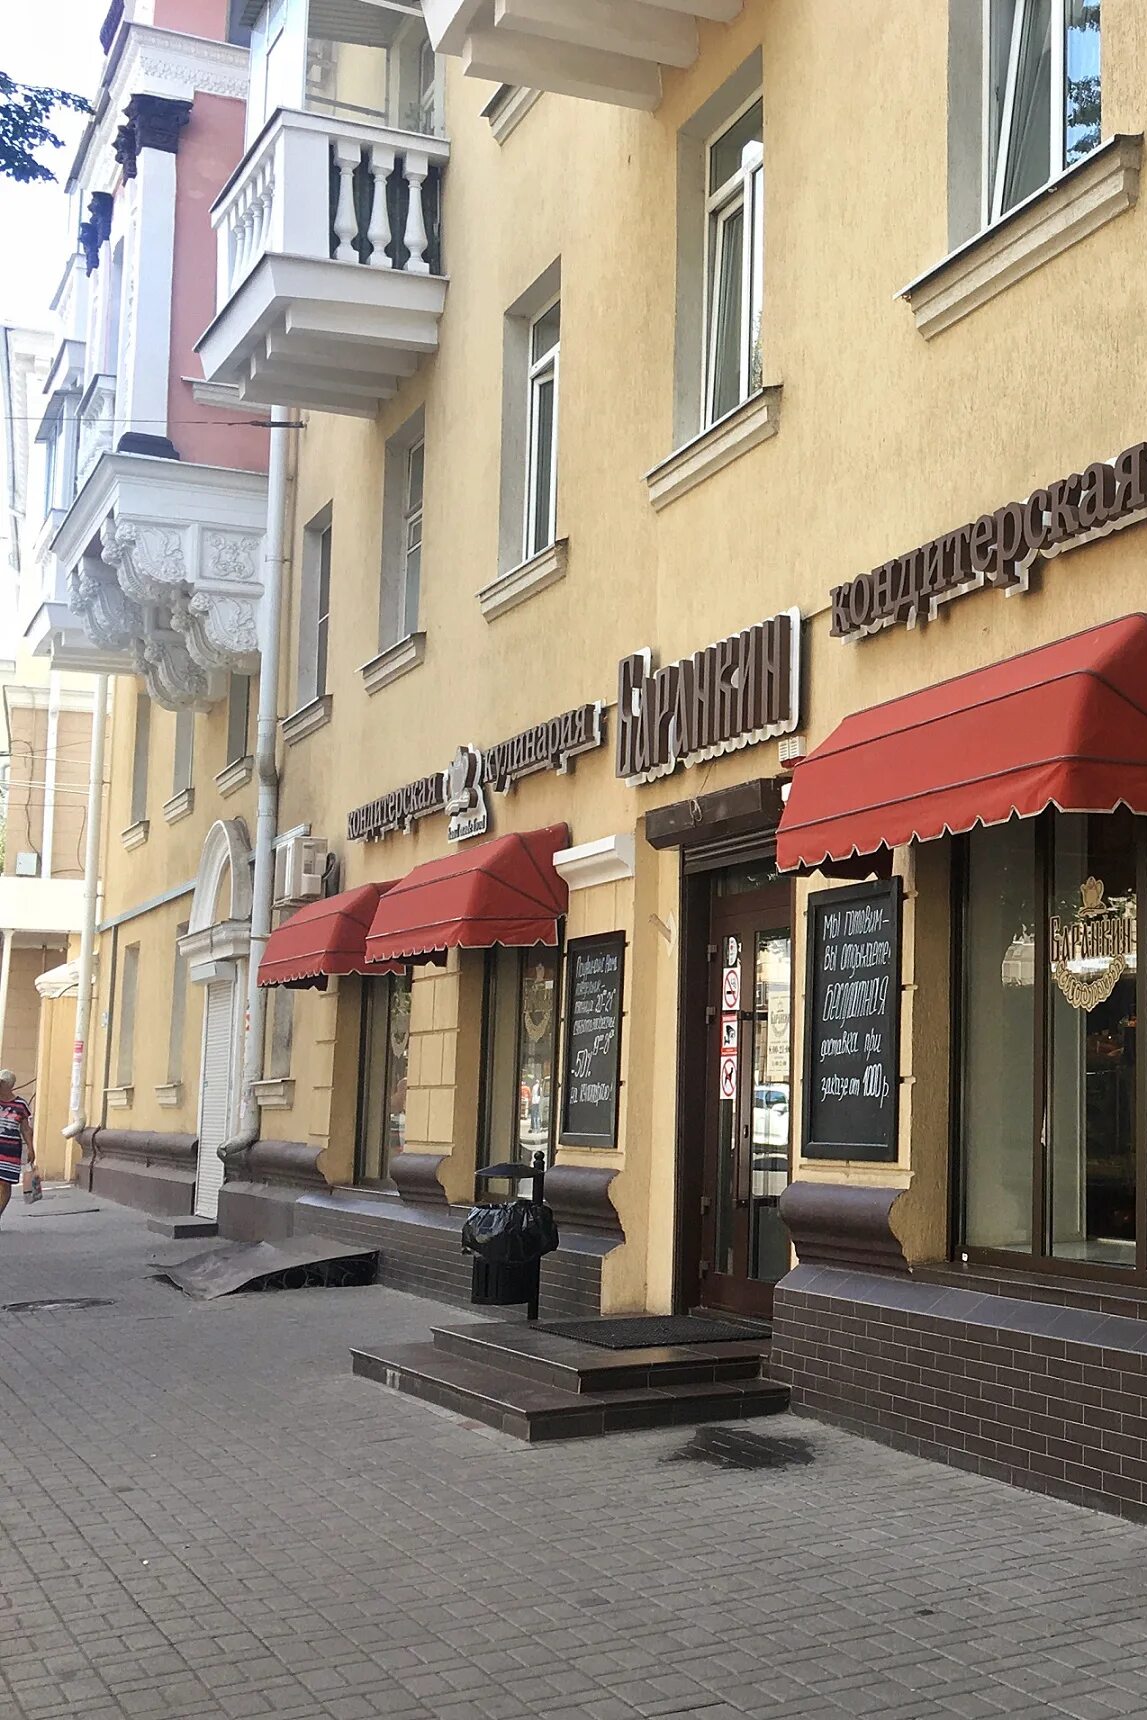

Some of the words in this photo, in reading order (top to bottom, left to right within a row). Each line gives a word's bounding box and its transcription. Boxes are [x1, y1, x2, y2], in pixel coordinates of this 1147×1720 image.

[483, 704, 595, 792] кулинария
[347, 772, 445, 841] кондитерская
[823, 911, 840, 941] Мы
